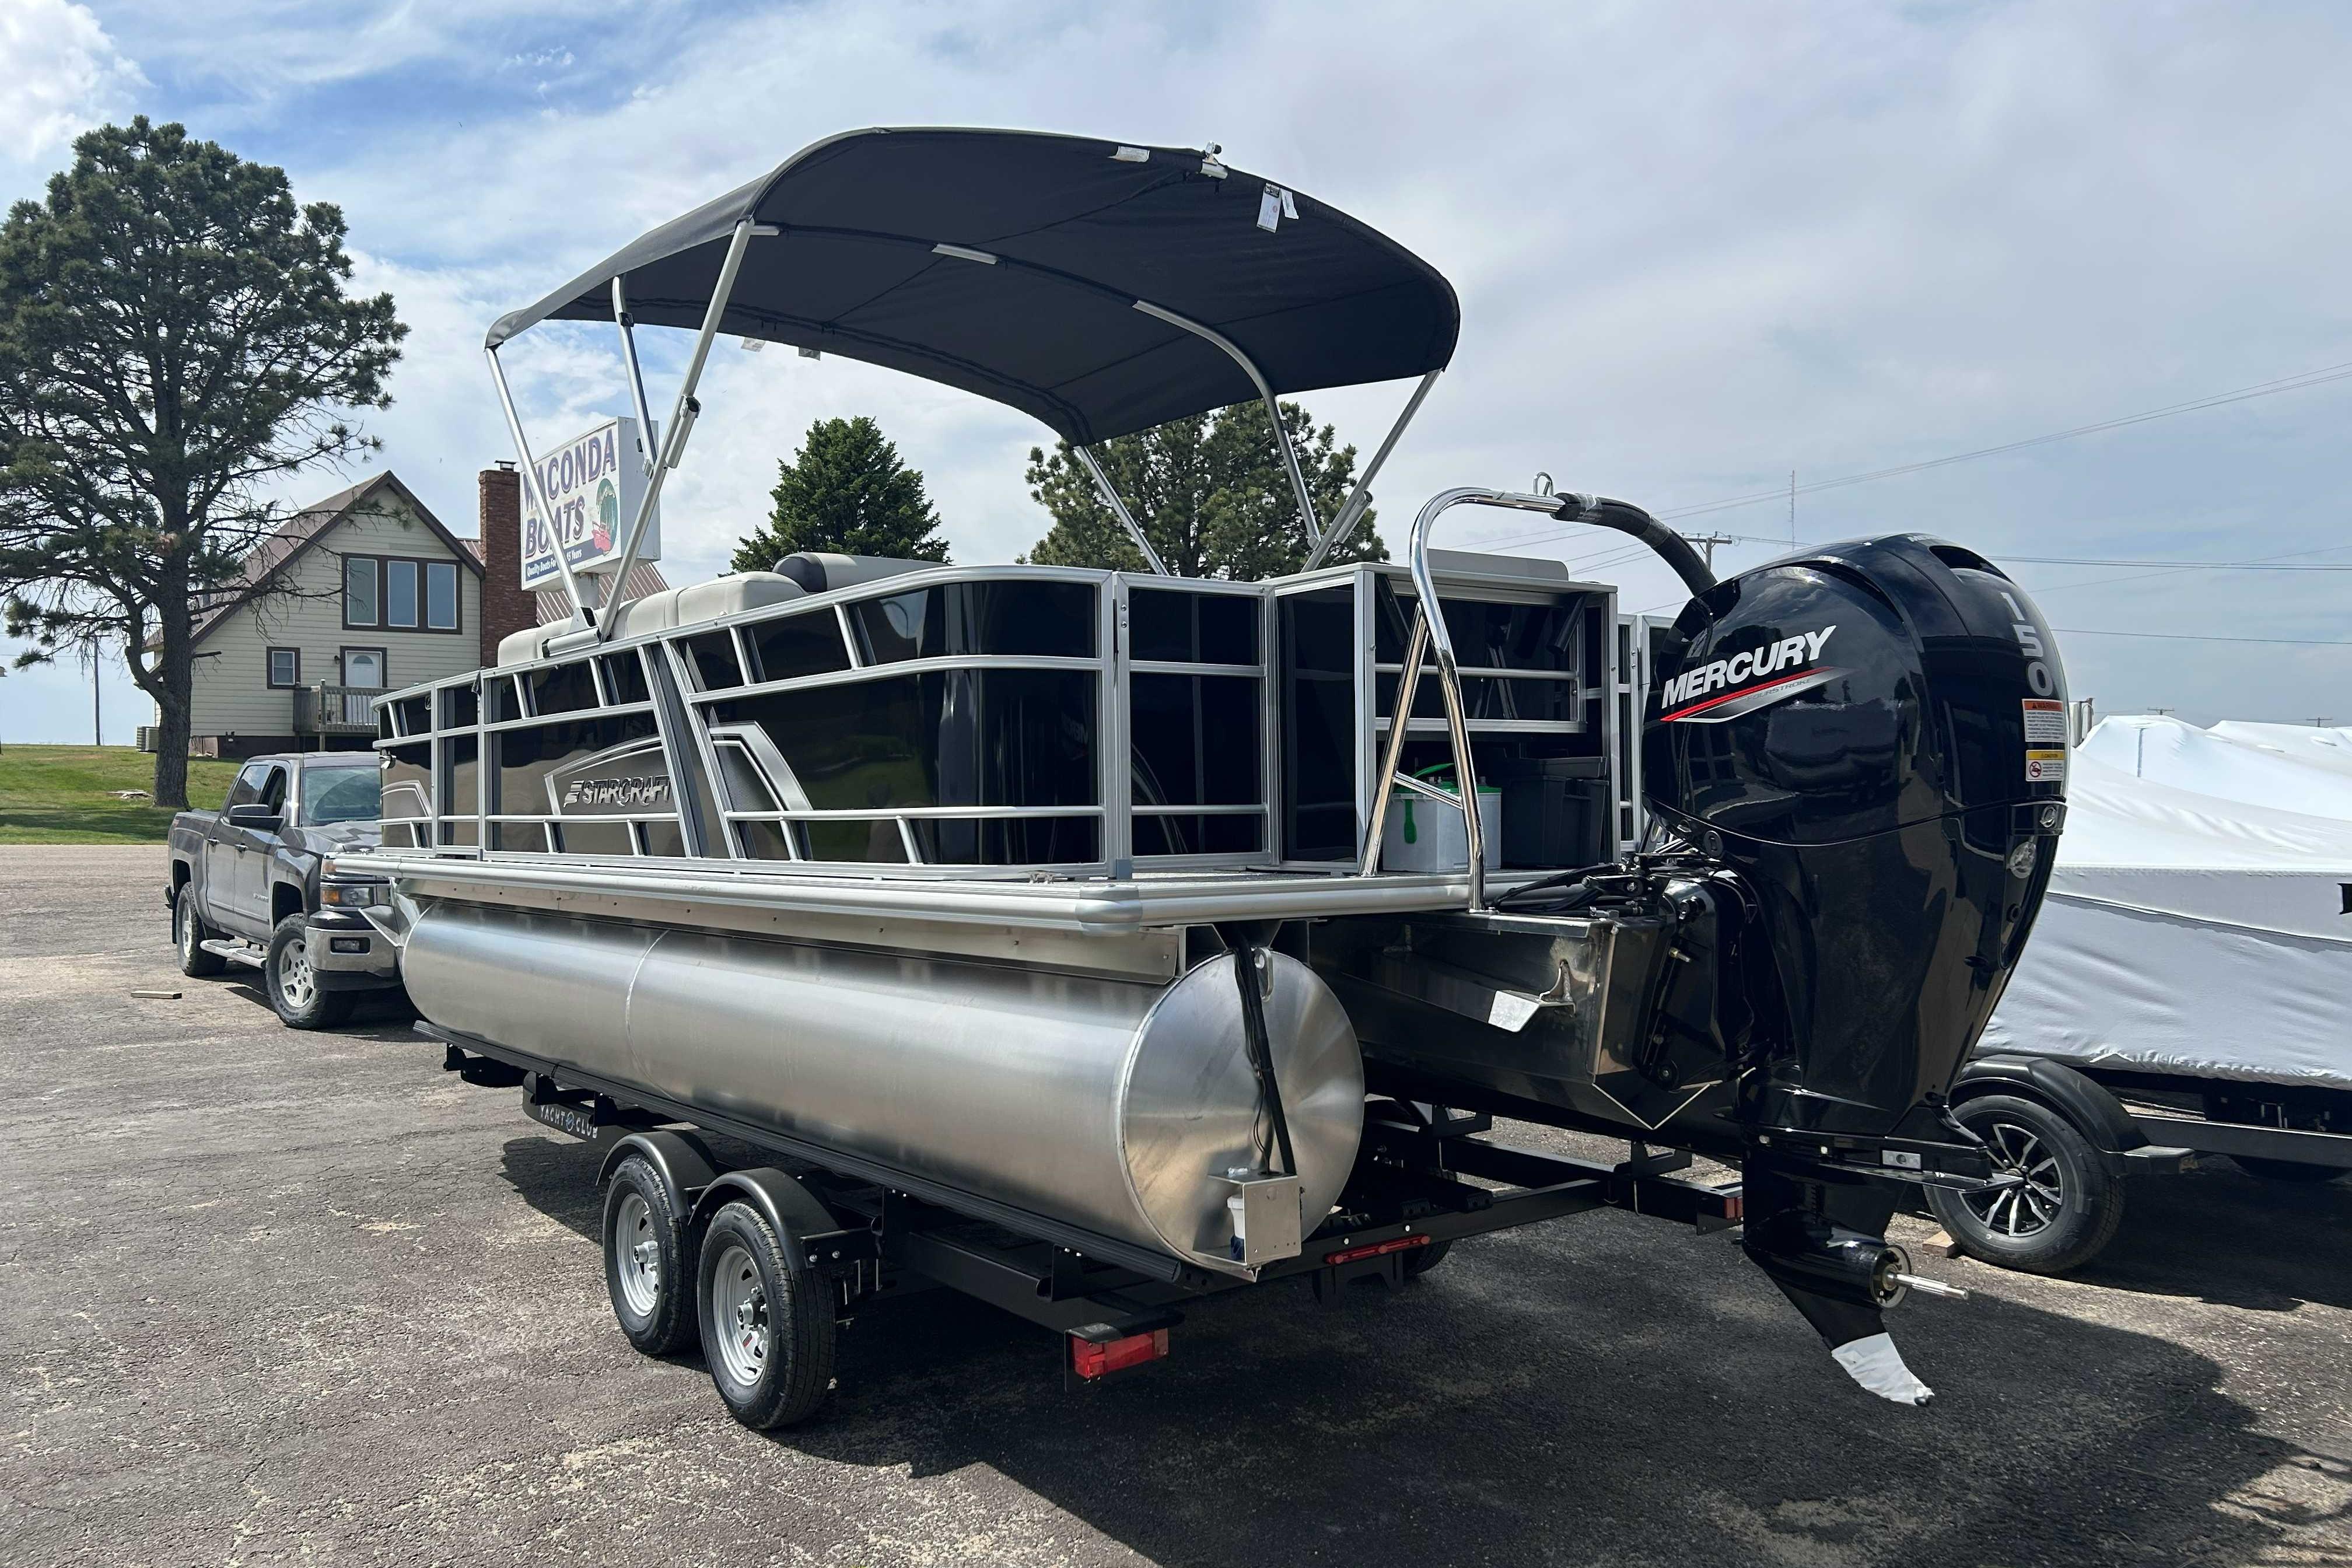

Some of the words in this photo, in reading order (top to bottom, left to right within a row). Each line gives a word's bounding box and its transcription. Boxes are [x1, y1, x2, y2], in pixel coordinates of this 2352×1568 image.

[526, 495, 585, 559] BOATS
[540, 559, 550, 572] Boats
[571, 549, 582, 560] Years
[2000, 592, 2053, 697] 150
[1661, 625, 1837, 709] MERCURY
[1745, 677, 1812, 700] FOURSTROKE
[582, 775, 670, 807] STARCRAFT
[540, 1105, 565, 1126] YACHT
[576, 1117, 598, 1139] CLUB
